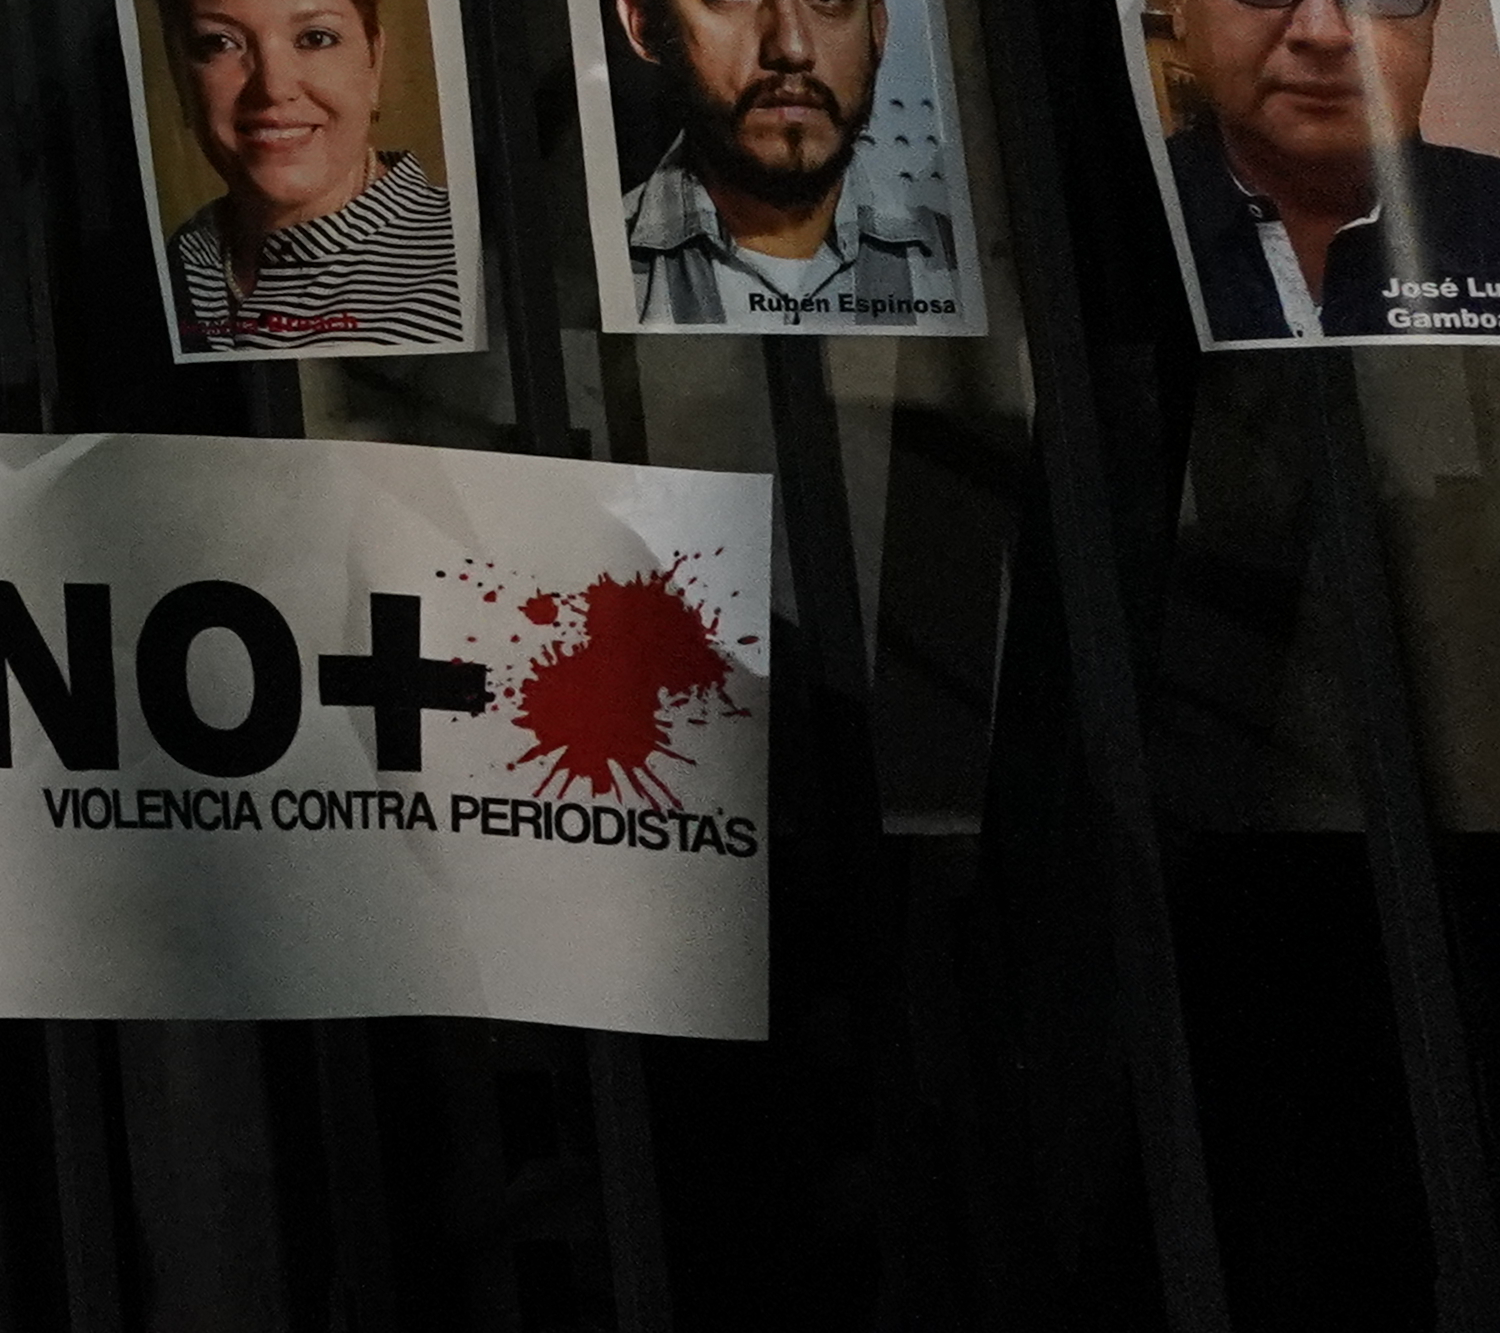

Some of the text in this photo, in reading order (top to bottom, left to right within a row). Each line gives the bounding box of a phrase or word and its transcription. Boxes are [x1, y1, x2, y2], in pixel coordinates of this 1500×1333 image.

[1381, 277, 1460, 299] José
[749, 292, 957, 317] Rubén Espinosa
[1387, 307, 1500, 329] Gambo
[43, 788, 758, 859] VIOLENCIA CONTRA PERIODISTAS
